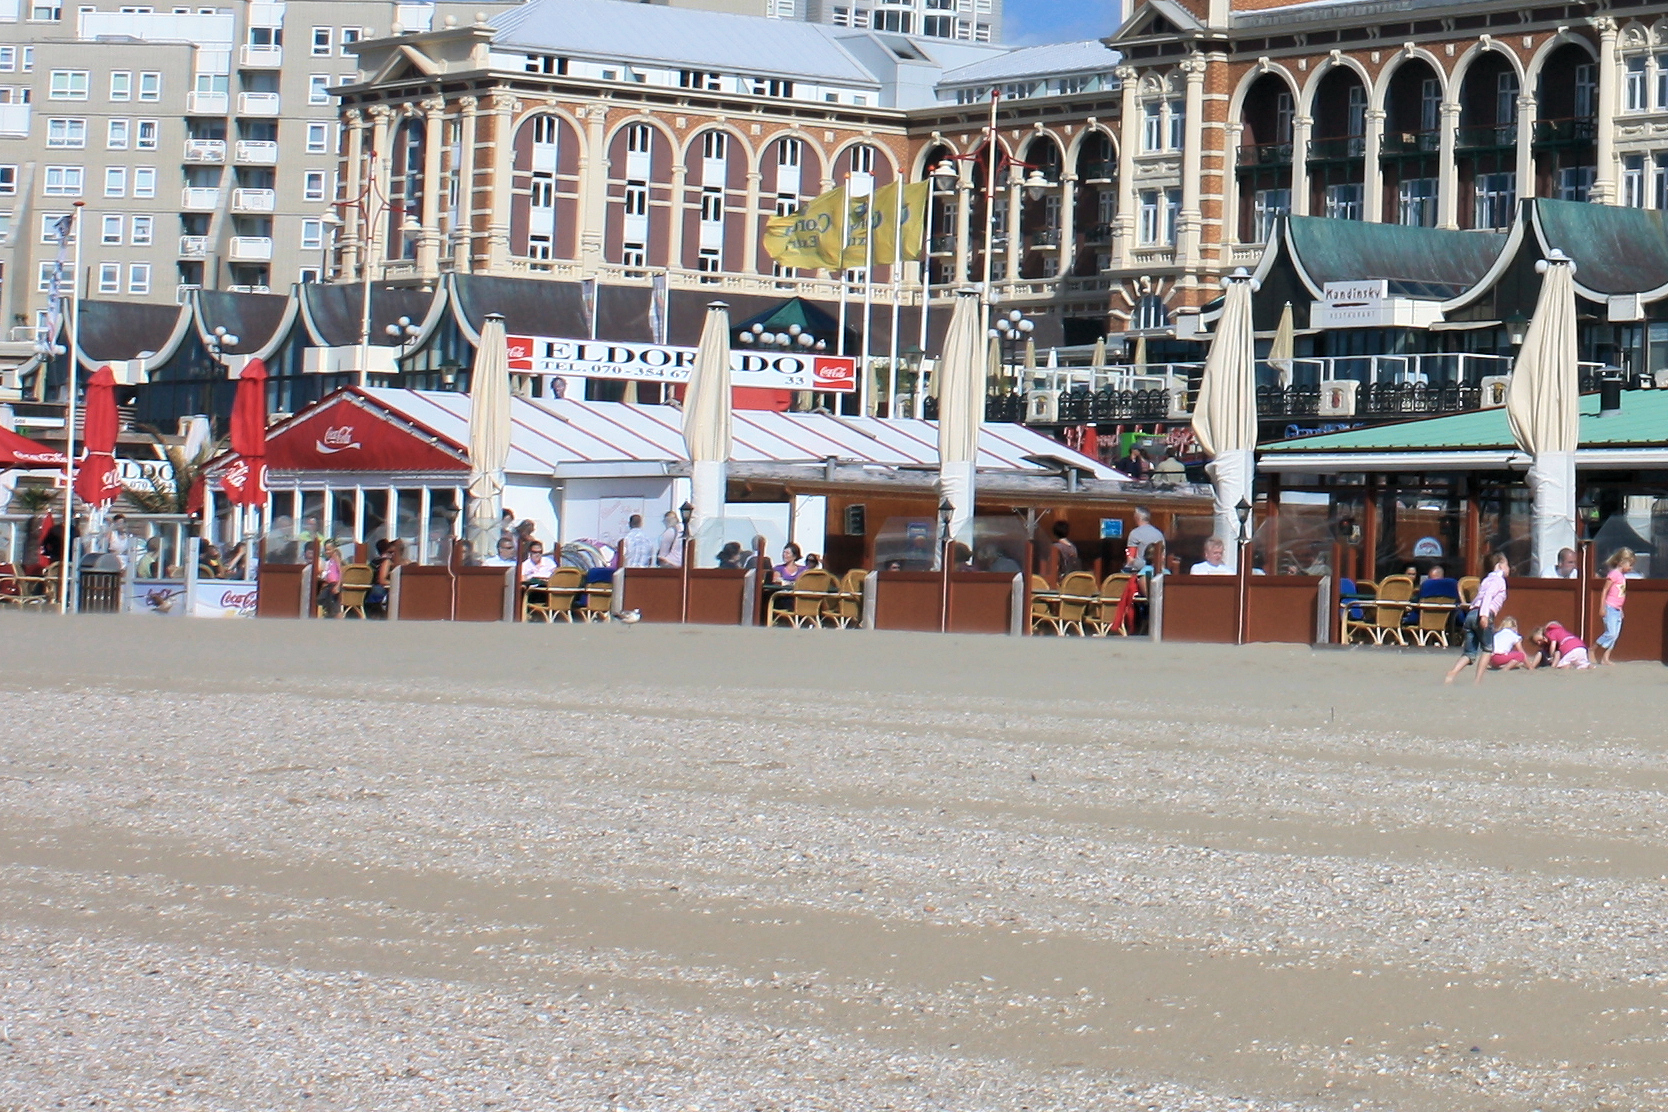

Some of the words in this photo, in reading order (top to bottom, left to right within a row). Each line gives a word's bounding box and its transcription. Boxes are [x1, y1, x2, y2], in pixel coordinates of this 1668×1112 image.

[1325, 286, 1381, 300] Kandinsky
[544, 340, 805, 375] ELDORDO
[541, 361, 587, 373] TEL.
